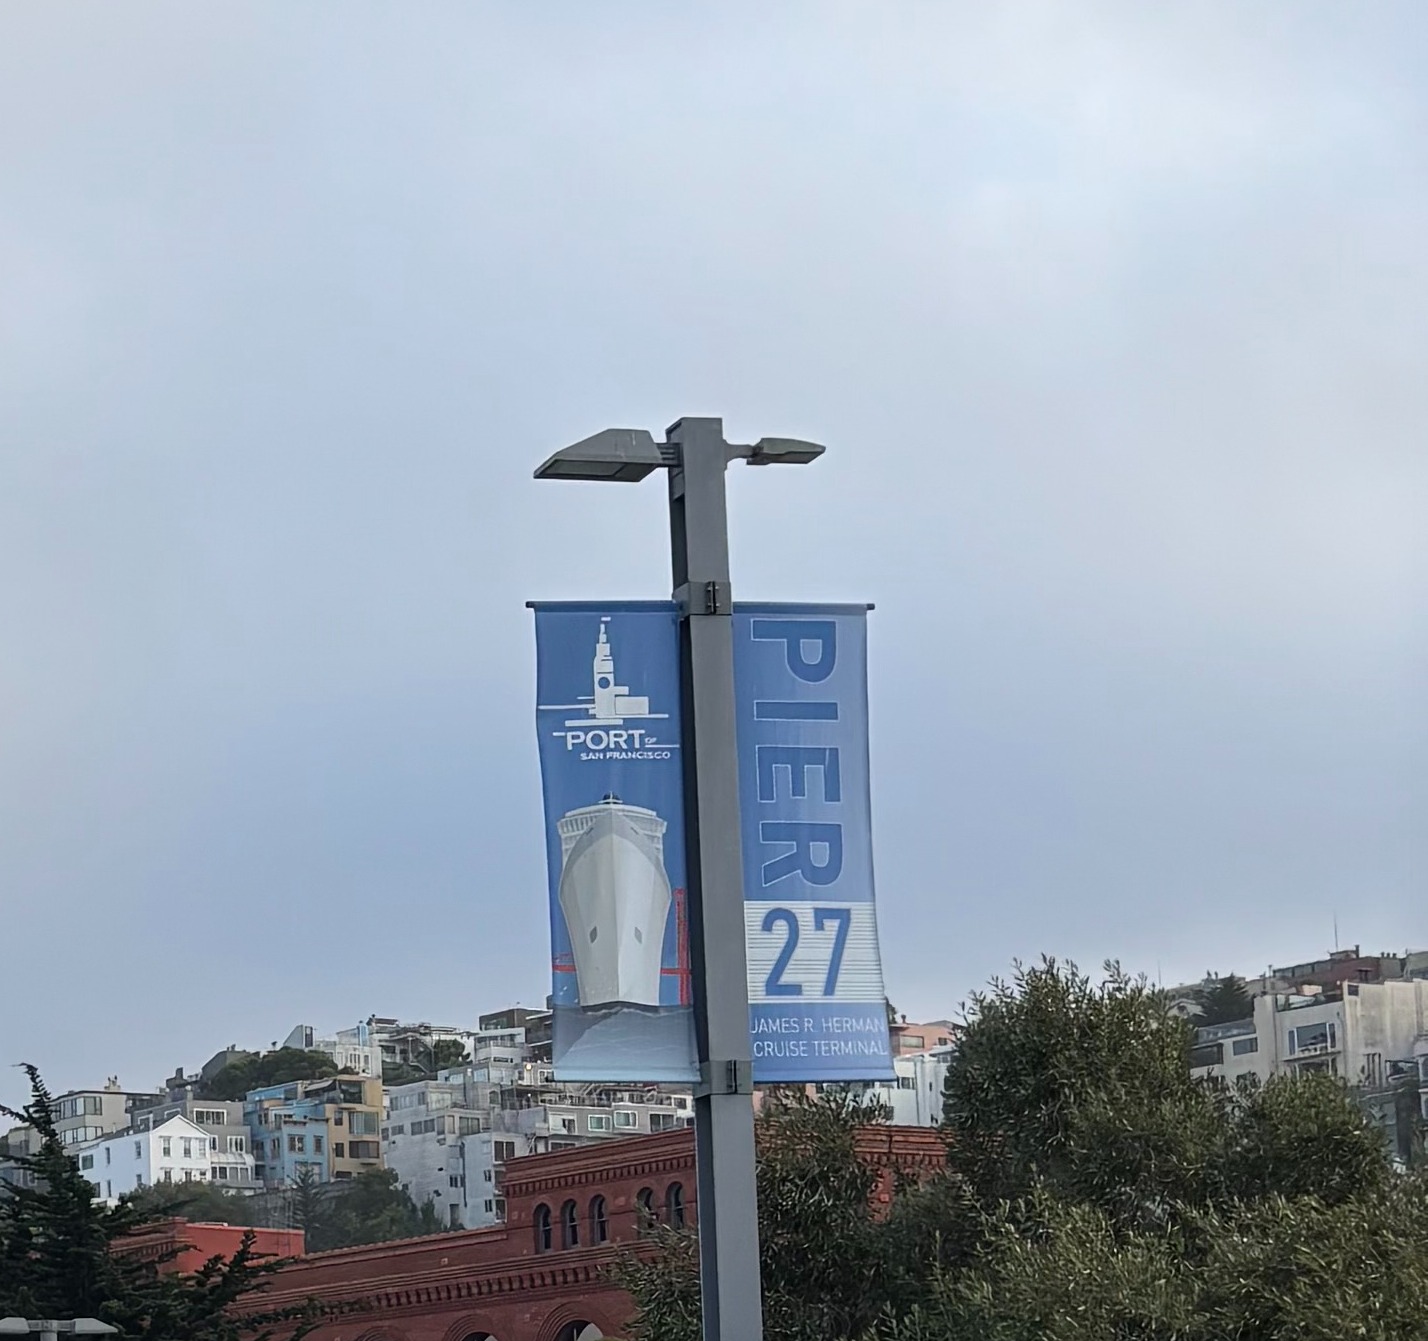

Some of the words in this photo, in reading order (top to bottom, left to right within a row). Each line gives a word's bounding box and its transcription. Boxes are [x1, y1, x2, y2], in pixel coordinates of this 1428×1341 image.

[566, 729, 645, 751] PORT
[580, 751, 604, 761] SAN
[606, 750, 671, 760] FRANCISCO
[749, 617, 844, 888] PIER
[761, 907, 852, 997] 27
[750, 1017, 799, 1034] JAMES
[822, 1016, 885, 1033] HERMAN
[753, 1040, 809, 1057] CRUISE
[812, 1039, 888, 1057] TERMINAL
